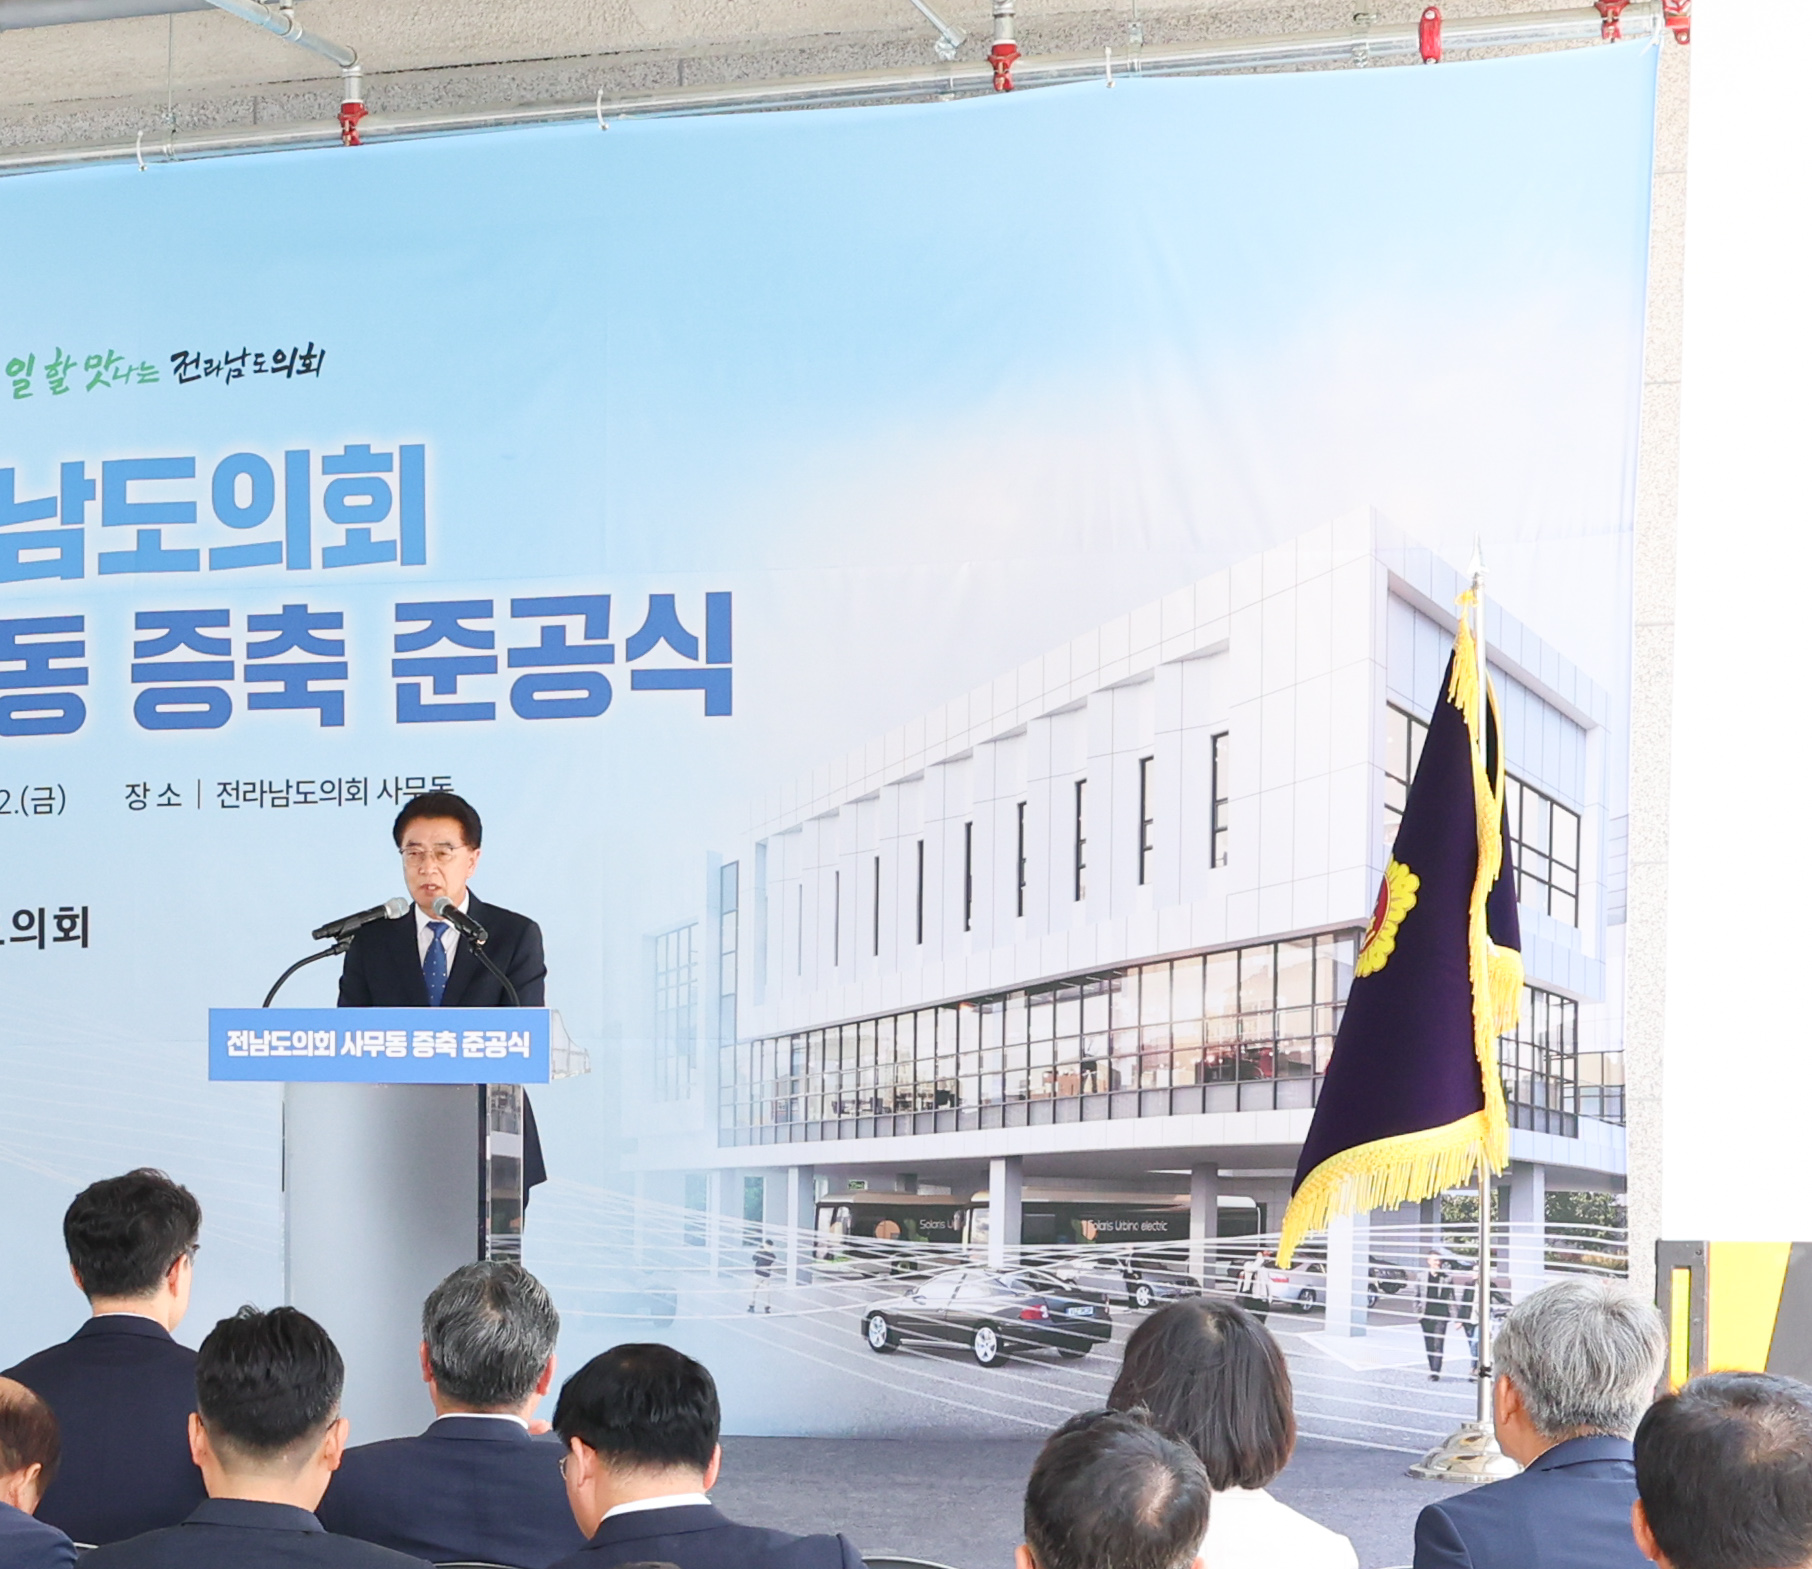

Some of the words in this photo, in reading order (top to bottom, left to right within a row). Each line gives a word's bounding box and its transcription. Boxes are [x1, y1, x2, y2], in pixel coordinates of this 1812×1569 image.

[4, 354, 36, 400] 일
[43, 347, 77, 396] 할
[83, 347, 160, 392] 맛나는
[170, 342, 326, 386] 전라남도의회
[130, 603, 348, 731] 증축
[391, 591, 733, 726] 준공식
[216, 777, 368, 809] 전라남도의회
[227, 1030, 336, 1057] 전남도의회
[340, 1030, 407, 1058] 사무동
[412, 1030, 457, 1058] 증축
[462, 1030, 530, 1058] 준공식
